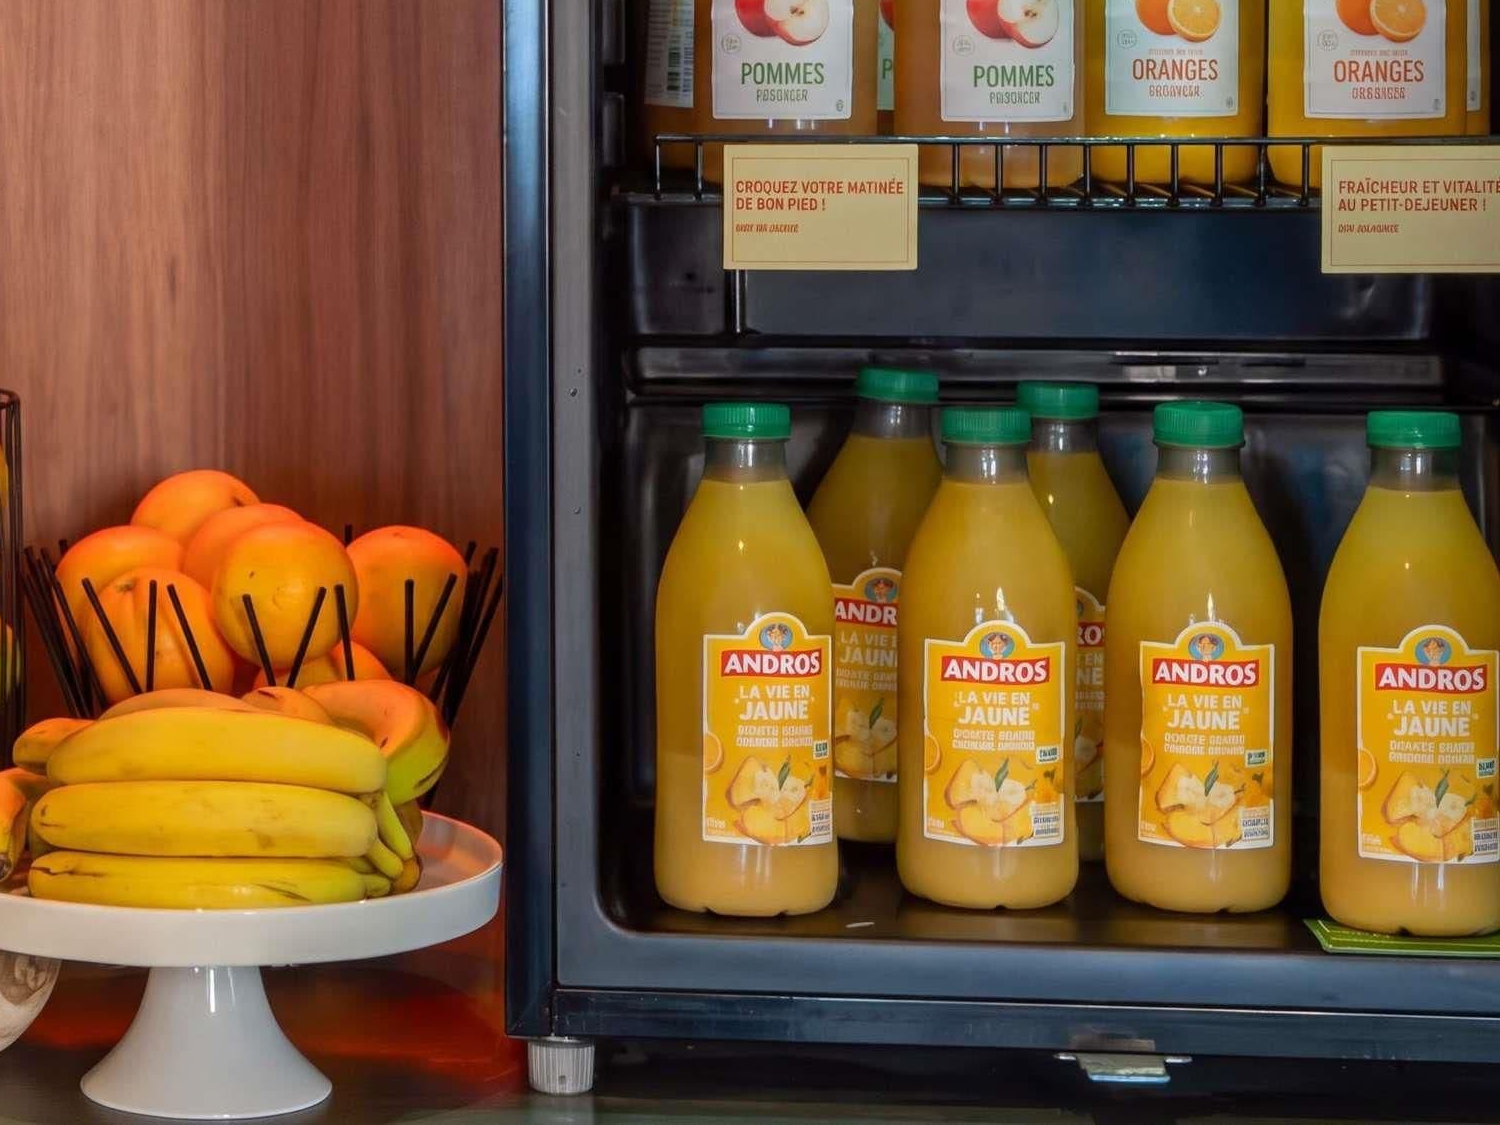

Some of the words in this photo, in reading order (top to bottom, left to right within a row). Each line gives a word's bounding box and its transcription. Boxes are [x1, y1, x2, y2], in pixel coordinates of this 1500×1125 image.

[741, 61, 825, 85] POMMES
[973, 65, 1055, 88] POMMES
[1132, 58, 1219, 82] ORANGES
[1334, 60, 1424, 83] ORANGES
[736, 180, 798, 195] CROQUEZ
[801, 180, 843, 194] VOTRE
[847, 177, 904, 195] MATINÉE
[1338, 177, 1418, 194] FRAÎCHEUR
[1423, 180, 1440, 194] ET
[736, 198, 752, 211] DE
[757, 198, 784, 211] BON
[788, 198, 818, 211] PIED
[1338, 198, 1356, 212] AU
[835, 601, 897, 625] ANDR
[724, 651, 820, 675] ANDROS
[840, 646, 897, 667] JAUN
[944, 658, 1047, 683] ANDROS
[1155, 661, 1257, 686] ANDROS
[1379, 667, 1485, 691] ANDROS
[739, 684, 760, 699] LA
[765, 684, 790, 699] VIE
[794, 684, 810, 699] EN
[958, 691, 978, 704] LA
[982, 691, 1007, 705] VIE
[1011, 692, 1031, 705] EN
[1168, 694, 1188, 708] LA
[1193, 694, 1219, 709] VIE
[1223, 694, 1243, 709] EN
[739, 700, 809, 721] JAUNE
[958, 706, 1031, 726] JAUNE
[1393, 700, 1416, 715] LA
[1421, 700, 1448, 715] VIE
[1452, 701, 1472, 715] EN
[1167, 710, 1241, 730] JAUNE
[1394, 716, 1471, 737] JAUNE
